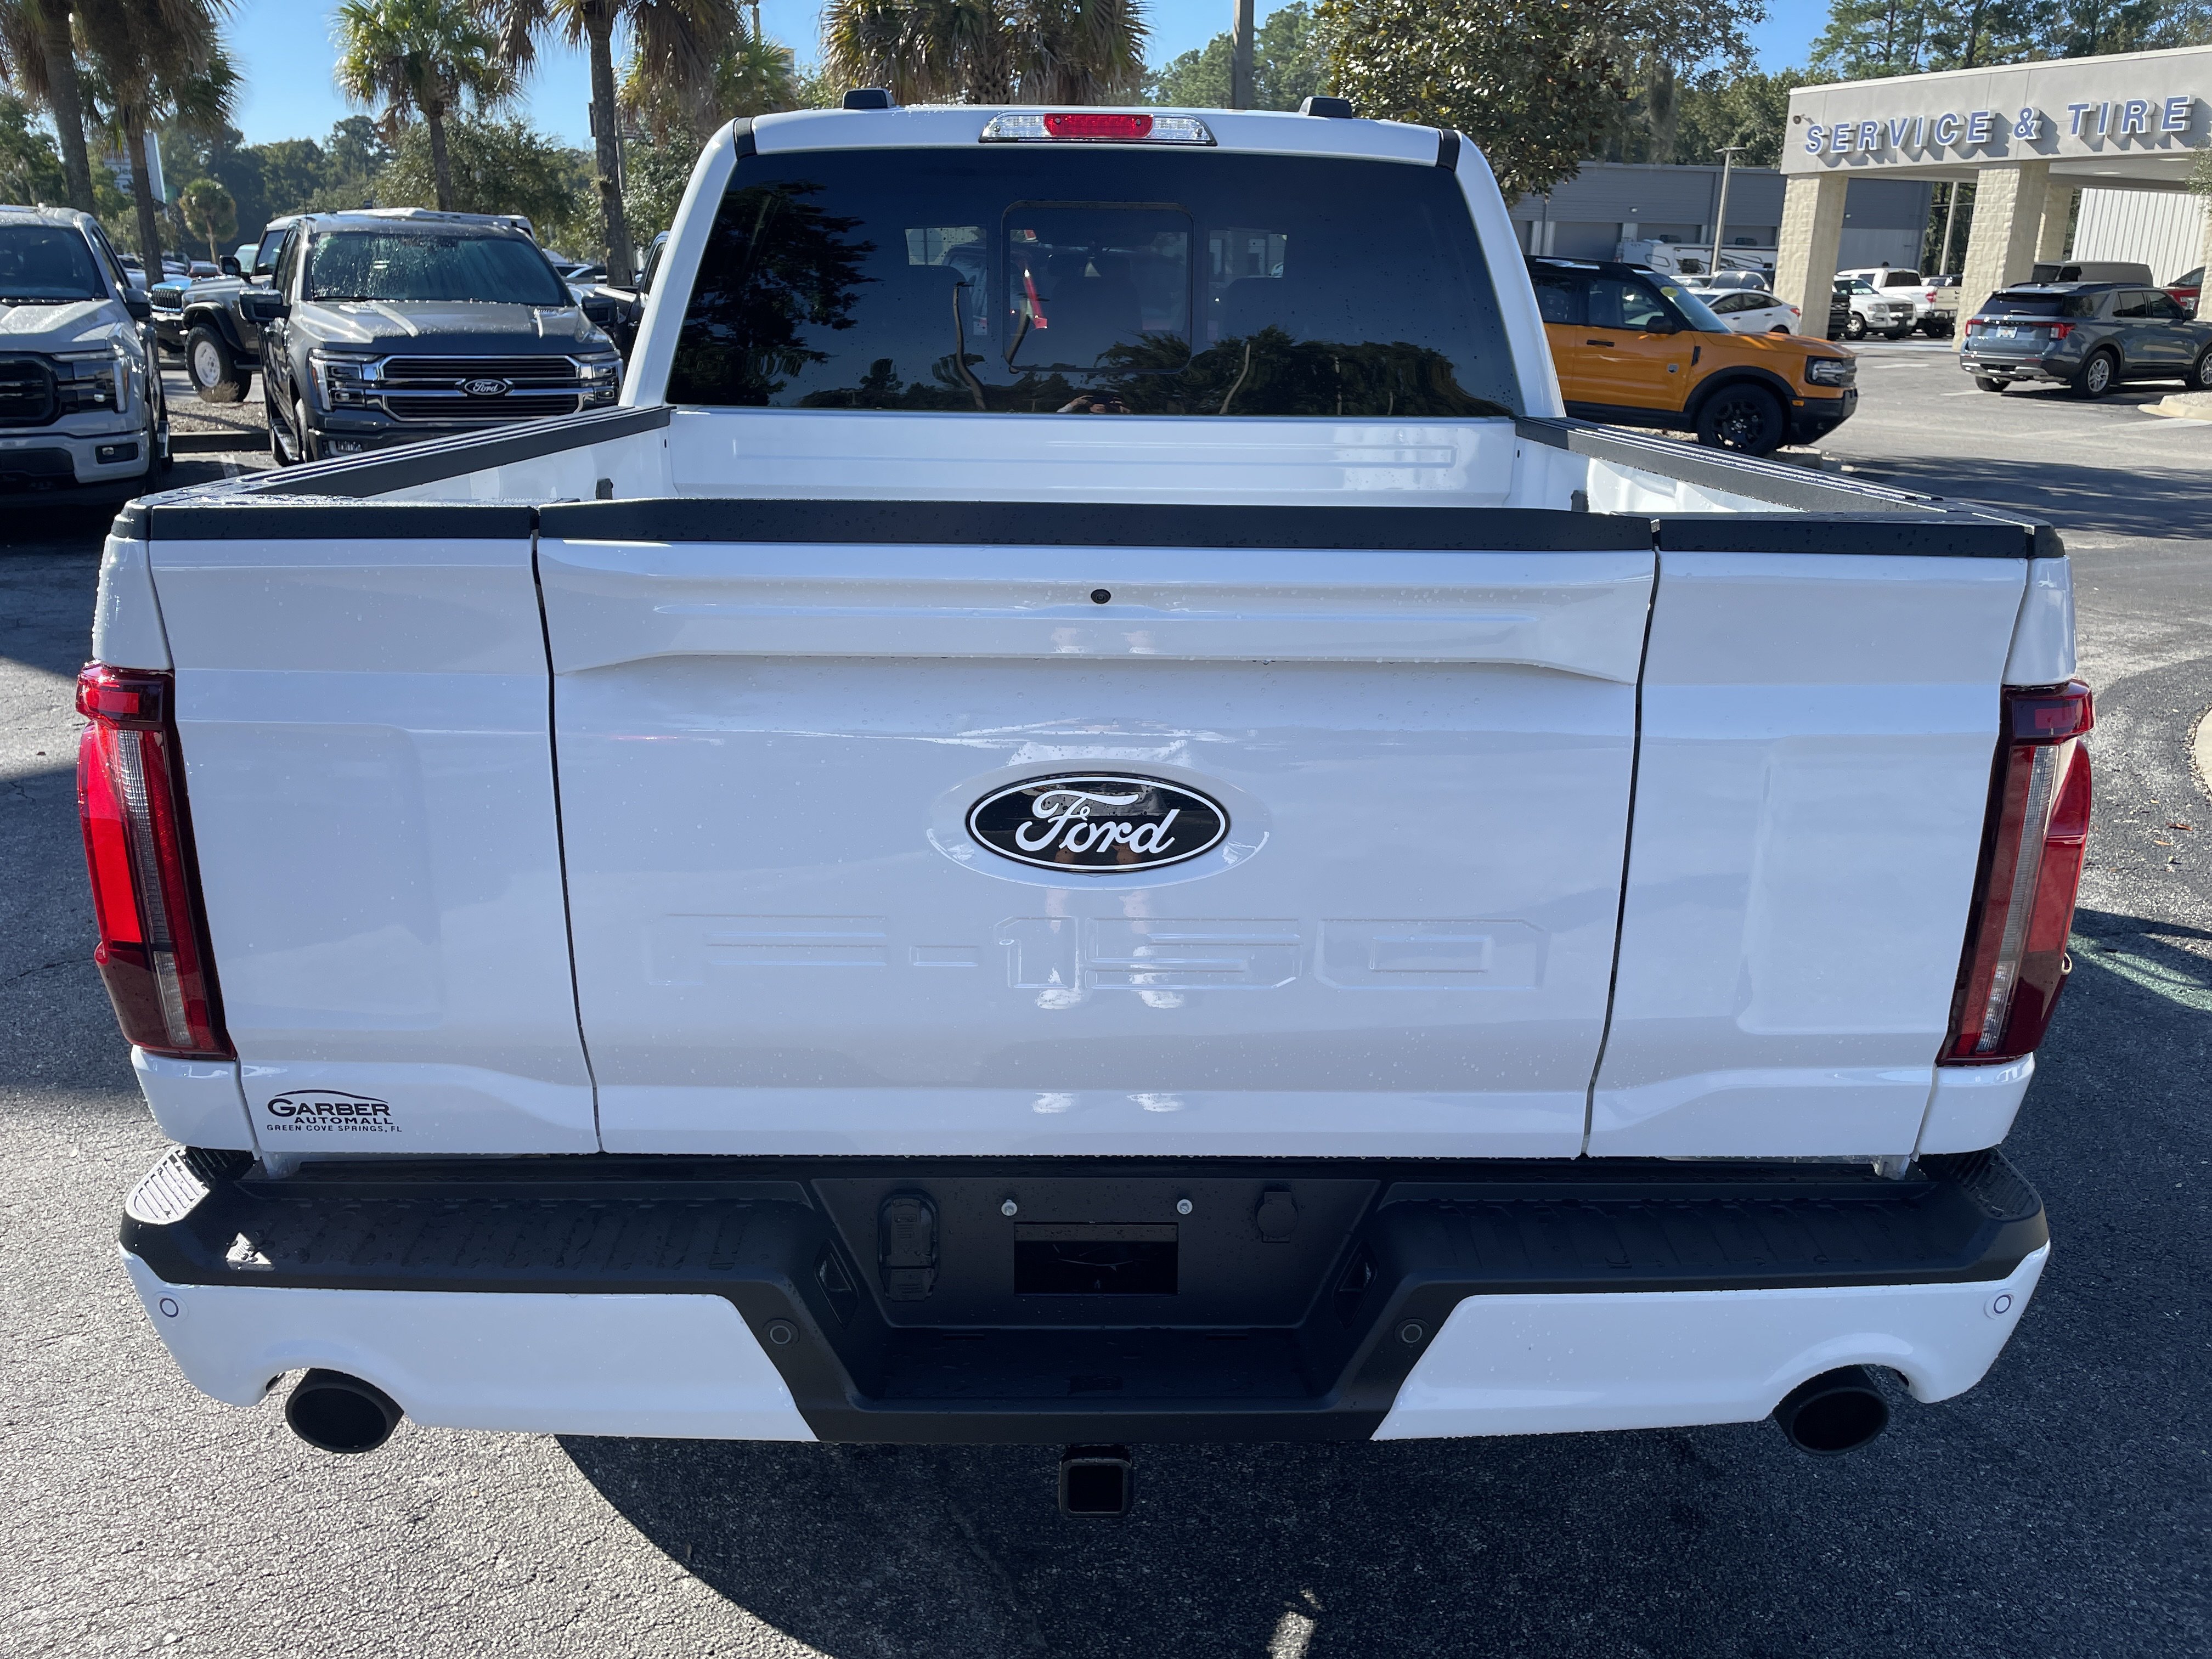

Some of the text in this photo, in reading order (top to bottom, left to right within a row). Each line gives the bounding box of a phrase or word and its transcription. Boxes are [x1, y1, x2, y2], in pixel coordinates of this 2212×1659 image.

[1804, 95, 2192, 155] SERVICE & TIRE
[473, 381, 498, 392] Ford
[1015, 789, 1180, 854] Ford
[644, 913, 1549, 990] F-150
[267, 1098, 392, 1117] GARBER
